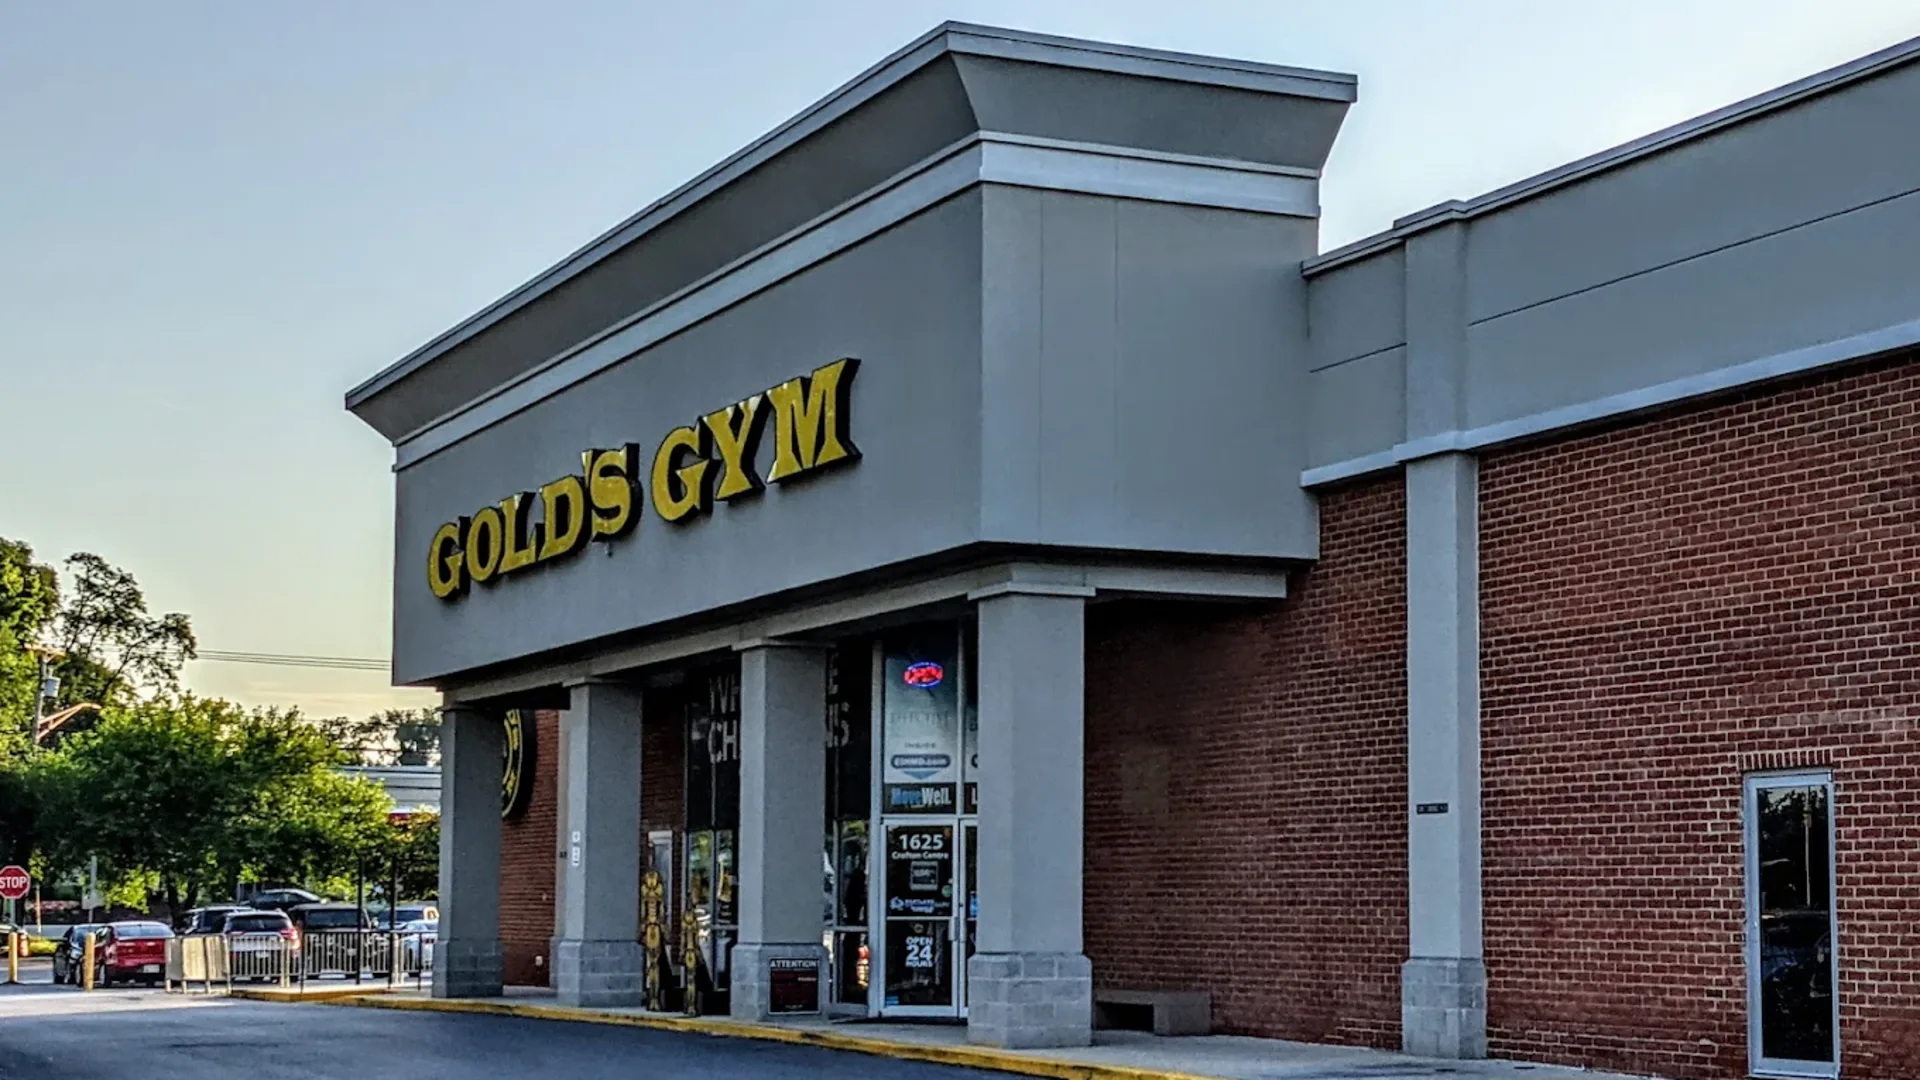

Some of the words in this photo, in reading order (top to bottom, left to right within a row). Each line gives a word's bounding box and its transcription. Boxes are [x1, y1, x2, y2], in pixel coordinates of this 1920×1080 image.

[427, 443, 642, 600] GOLD'S
[651, 357, 862, 522] GYM
[899, 834, 944, 850] 1625
[922, 851, 949, 860] Centre
[0, 876, 27, 889] STOP
[905, 936, 933, 946] OPEN
[905, 945, 932, 961] 24
[770, 960, 817, 968] ATTENTION
